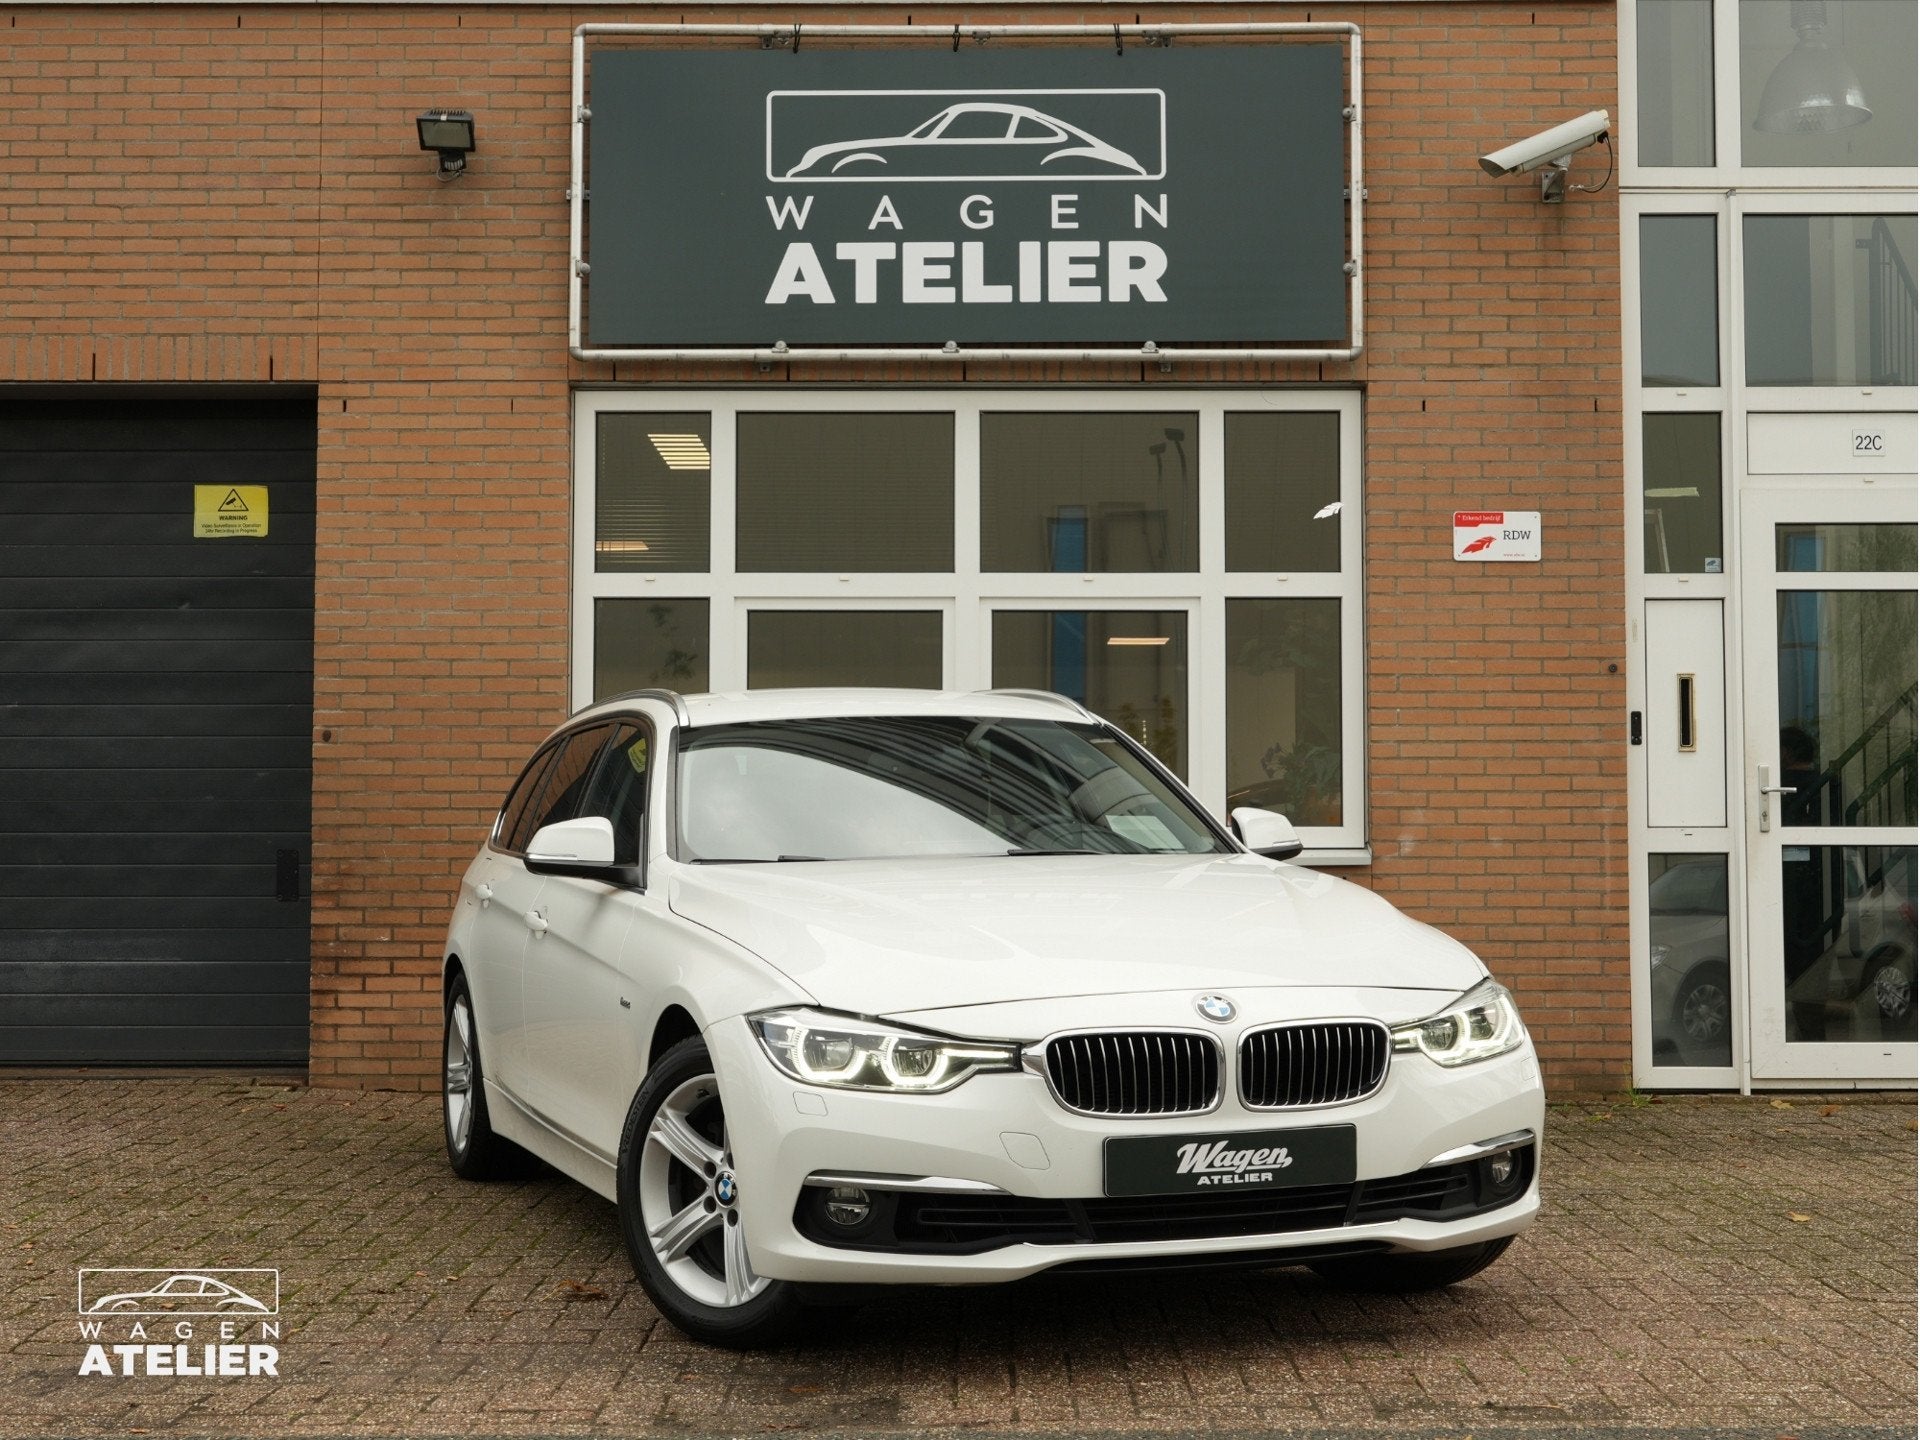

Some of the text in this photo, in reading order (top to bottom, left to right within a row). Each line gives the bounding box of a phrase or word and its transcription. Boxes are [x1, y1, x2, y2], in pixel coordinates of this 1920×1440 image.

[765, 193, 1168, 230] WAGEN
[764, 240, 1168, 304] ATELIER
[1855, 435, 1882, 450] 22C
[1503, 530, 1531, 540] RDW
[1176, 1140, 1293, 1174] Wagen
[1197, 1172, 1273, 1186] ATELIER
